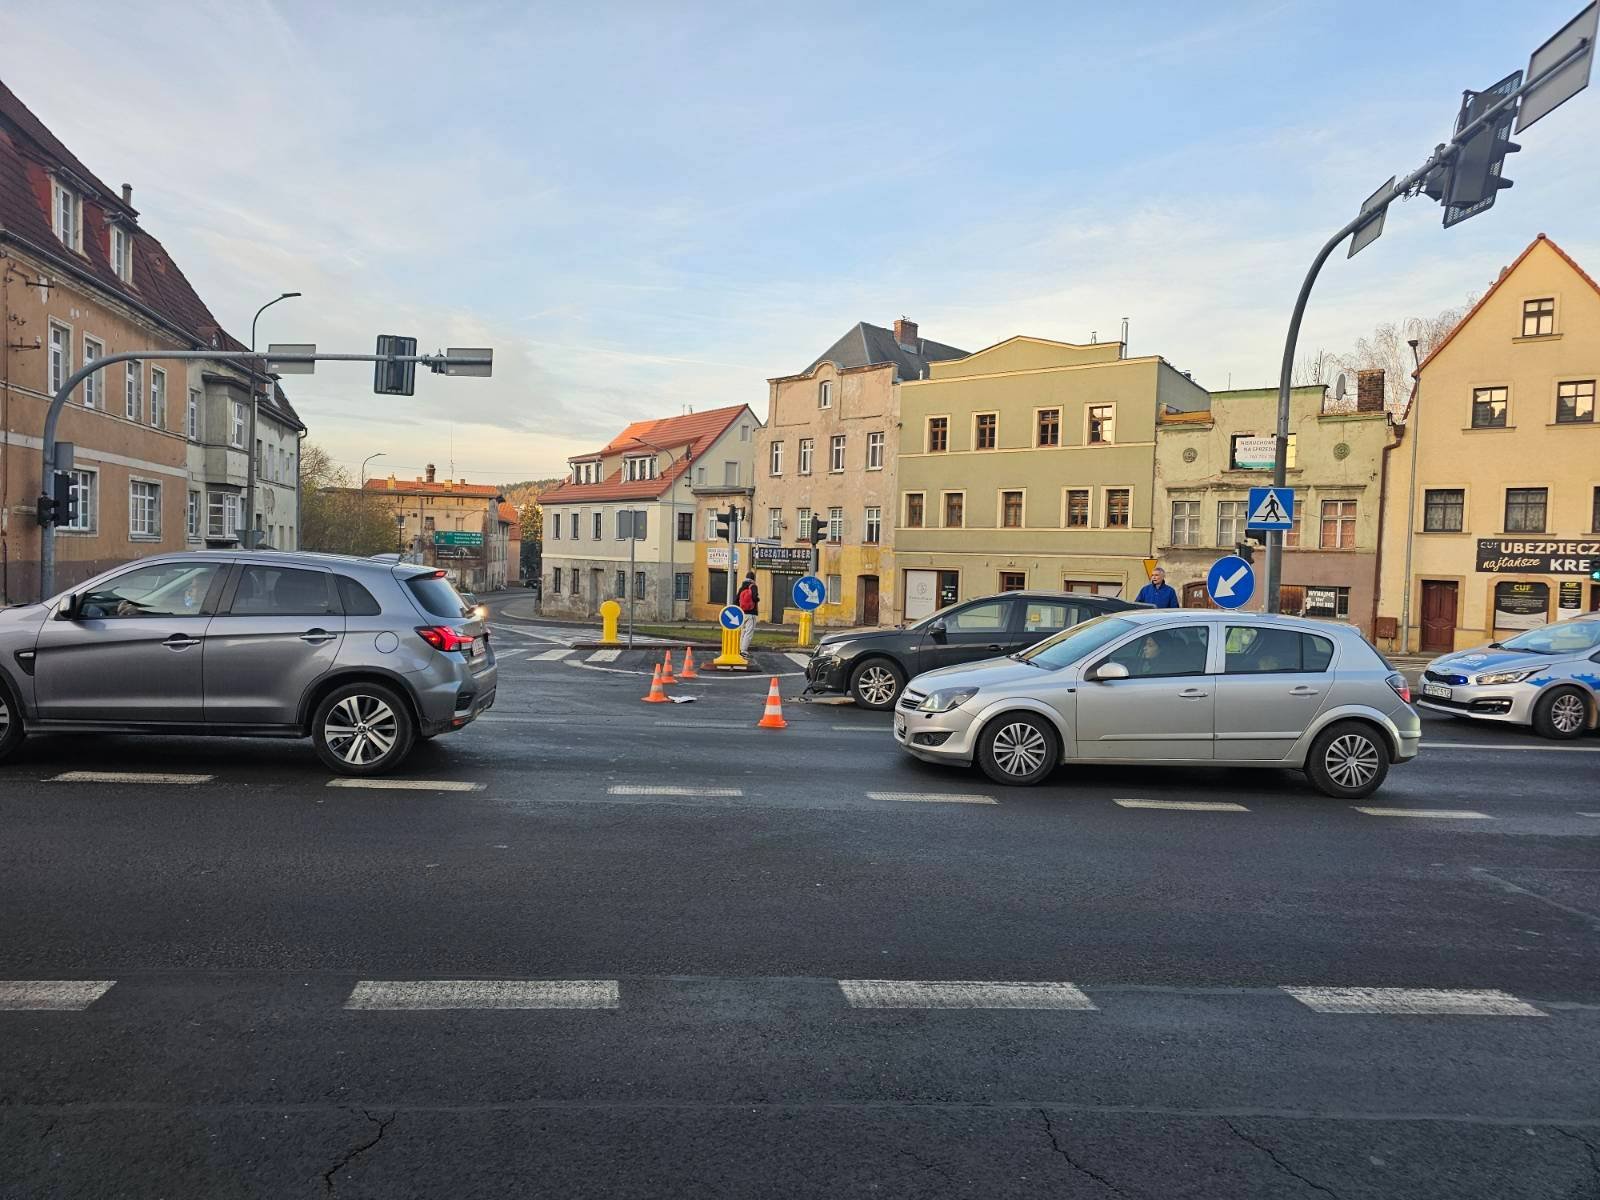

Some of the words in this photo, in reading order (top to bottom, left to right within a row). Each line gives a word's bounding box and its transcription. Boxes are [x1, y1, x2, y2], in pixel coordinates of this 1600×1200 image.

[1501, 543, 1600, 555] UBEZPIECZ
[1483, 557, 1541, 571] najtańsze
[1550, 559, 1591, 572] KRE
